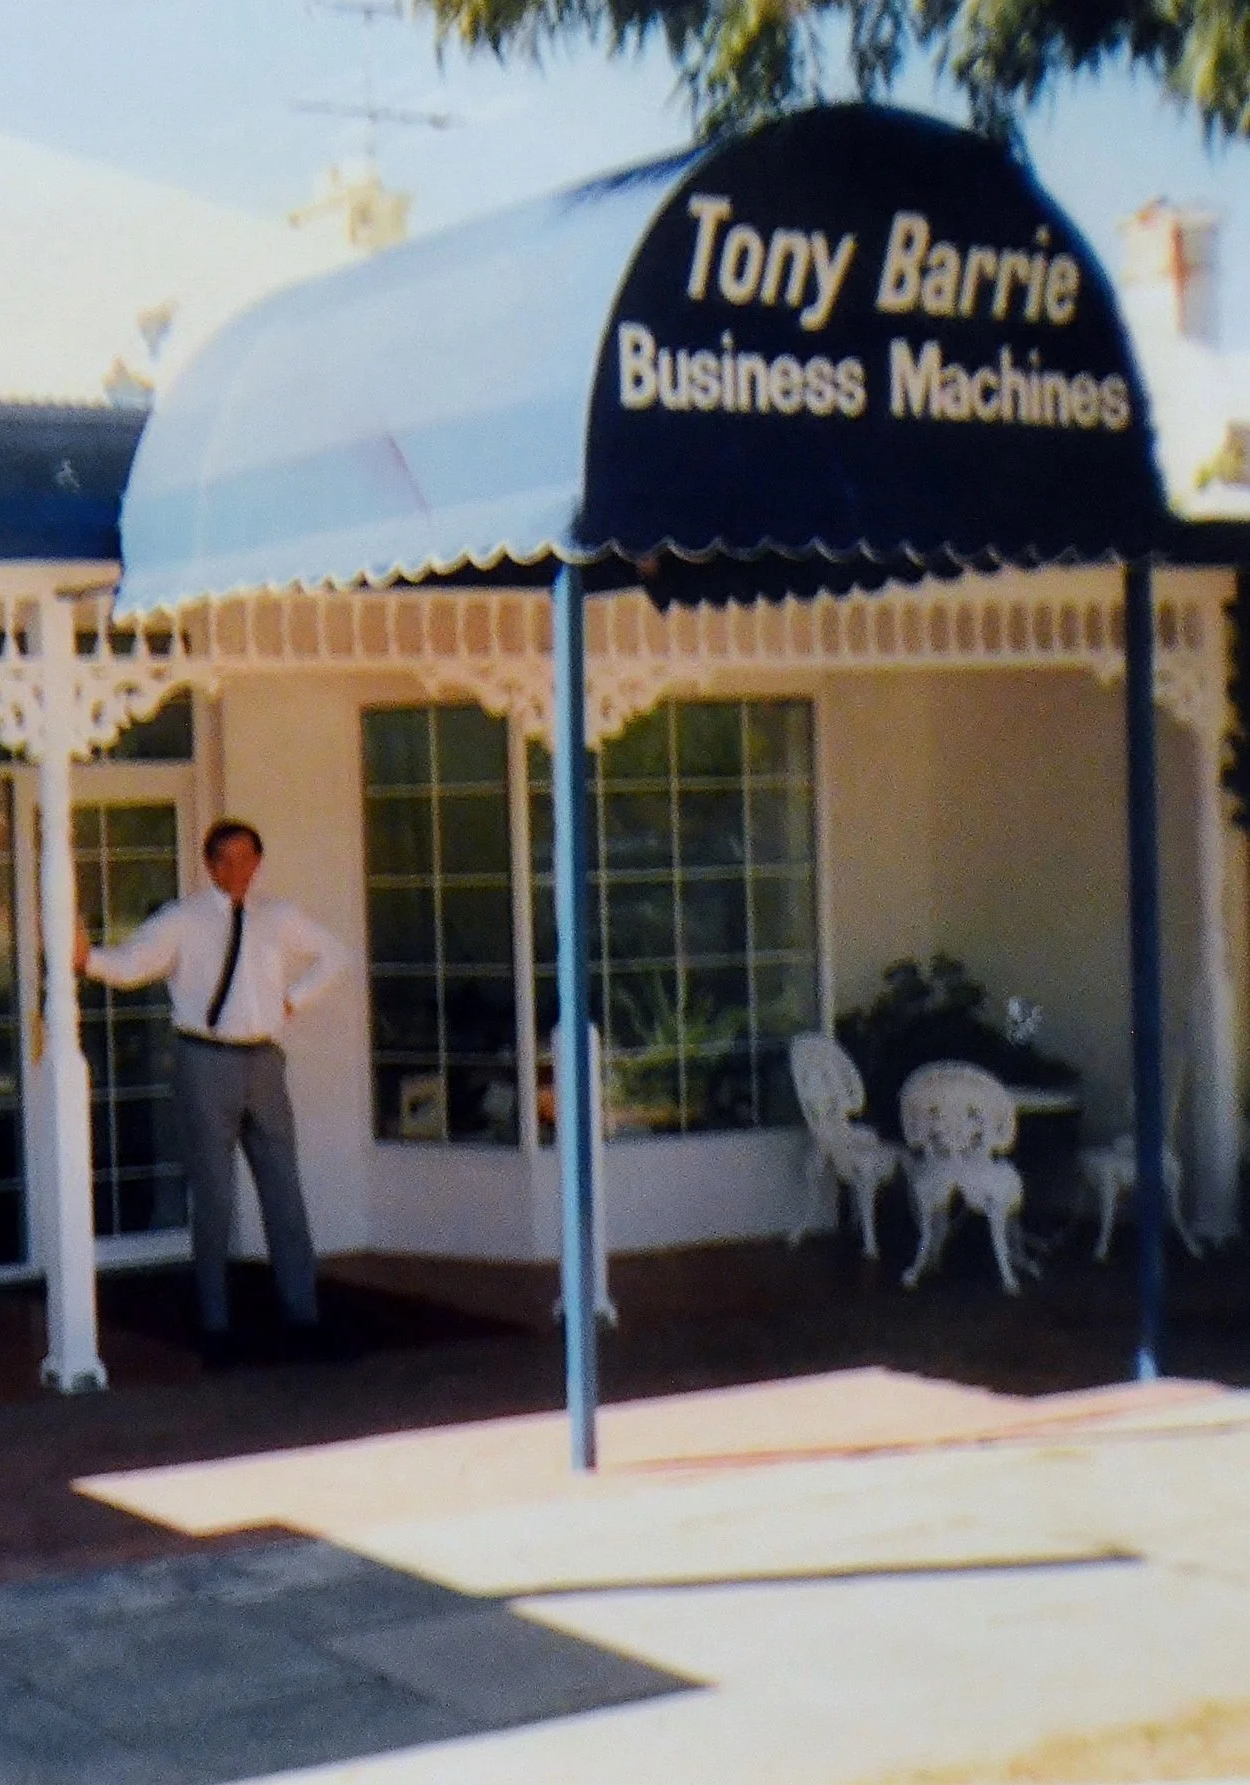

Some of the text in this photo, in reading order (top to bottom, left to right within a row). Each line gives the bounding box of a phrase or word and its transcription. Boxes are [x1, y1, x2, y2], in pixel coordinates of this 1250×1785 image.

[686, 192, 1081, 332] Tony Barrie
[617, 320, 1132, 434] Business Machines
